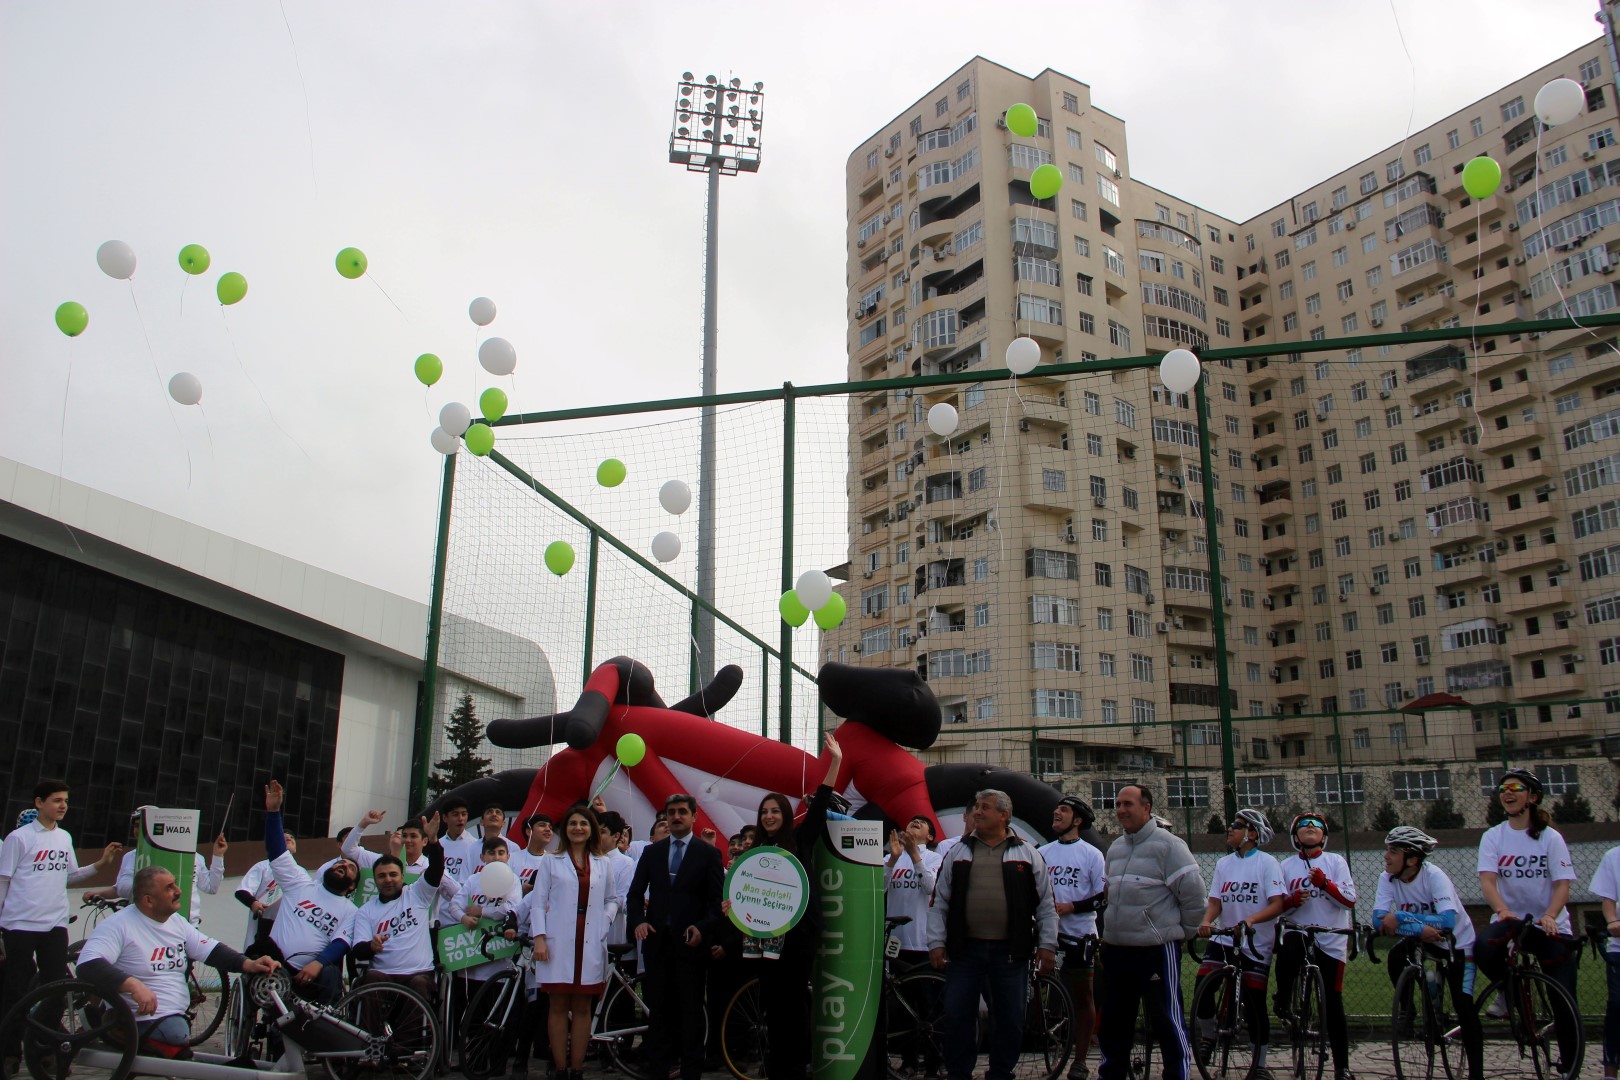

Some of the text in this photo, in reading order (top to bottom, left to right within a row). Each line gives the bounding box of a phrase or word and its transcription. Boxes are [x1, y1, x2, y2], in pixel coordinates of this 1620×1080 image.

[166, 826, 191, 834] WADA
[855, 838, 879, 847] WADA
[33, 864, 45, 872] TO
[1499, 868, 1548, 879] TO DOPE
[1053, 877, 1079, 889] DOPE
[1231, 894, 1258, 904] DOPE
[293, 907, 335, 937] TO DOPE
[393, 917, 419, 937] DOPE
[752, 918, 771, 927] AMADA
[443, 929, 477, 952] SAY
[887, 939, 899, 956] 101
[446, 951, 463, 963] TO
[152, 962, 165, 971] TO
[816, 867, 856, 1061] play true
